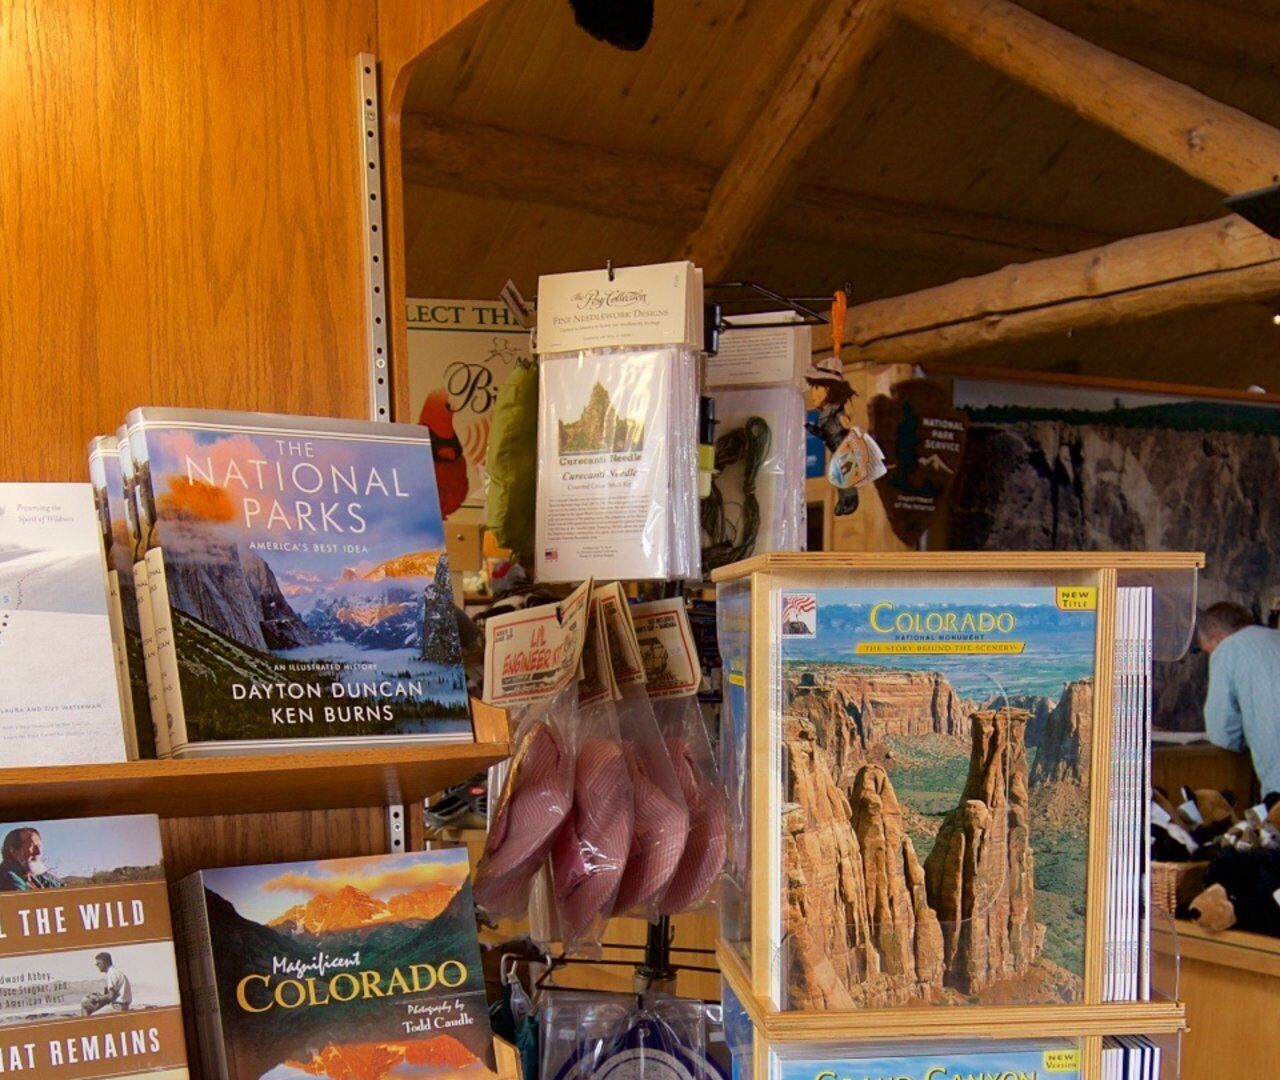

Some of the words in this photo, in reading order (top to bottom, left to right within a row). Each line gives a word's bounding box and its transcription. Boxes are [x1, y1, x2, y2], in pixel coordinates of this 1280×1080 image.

[553, 315, 571, 326] FINE
[574, 310, 633, 324] NEEDLEWORK
[633, 307, 669, 320] DESIGNS
[275, 439, 315, 459] THE
[560, 457, 608, 467] Curecanti
[610, 453, 642, 464] Needle
[185, 454, 411, 499] NATIONAL
[562, 471, 605, 482] Curecanti
[243, 497, 368, 534] PARKS
[248, 539, 308, 554] AMERICA'S
[313, 542, 339, 554] BEST
[343, 543, 370, 555] IDEA
[1061, 591, 1090, 600] NEW
[869, 601, 1016, 634] COLORADO
[273, 662, 287, 672] AN
[288, 661, 341, 672] ILLUSTRATED
[344, 662, 378, 672] HISTORY
[231, 681, 322, 701] DAYTON
[331, 679, 424, 700] DUNCAN
[271, 704, 315, 726] KEN
[324, 703, 395, 724] BURNS
[18, 906, 67, 938] THE
[79, 898, 146, 931] WILD
[271, 951, 362, 980] Magnificent
[236, 959, 469, 1014] COLORADO
[401, 1018, 432, 1035] Todd
[433, 1013, 475, 1030] Caudle
[50, 1027, 161, 1067] REMAINS
